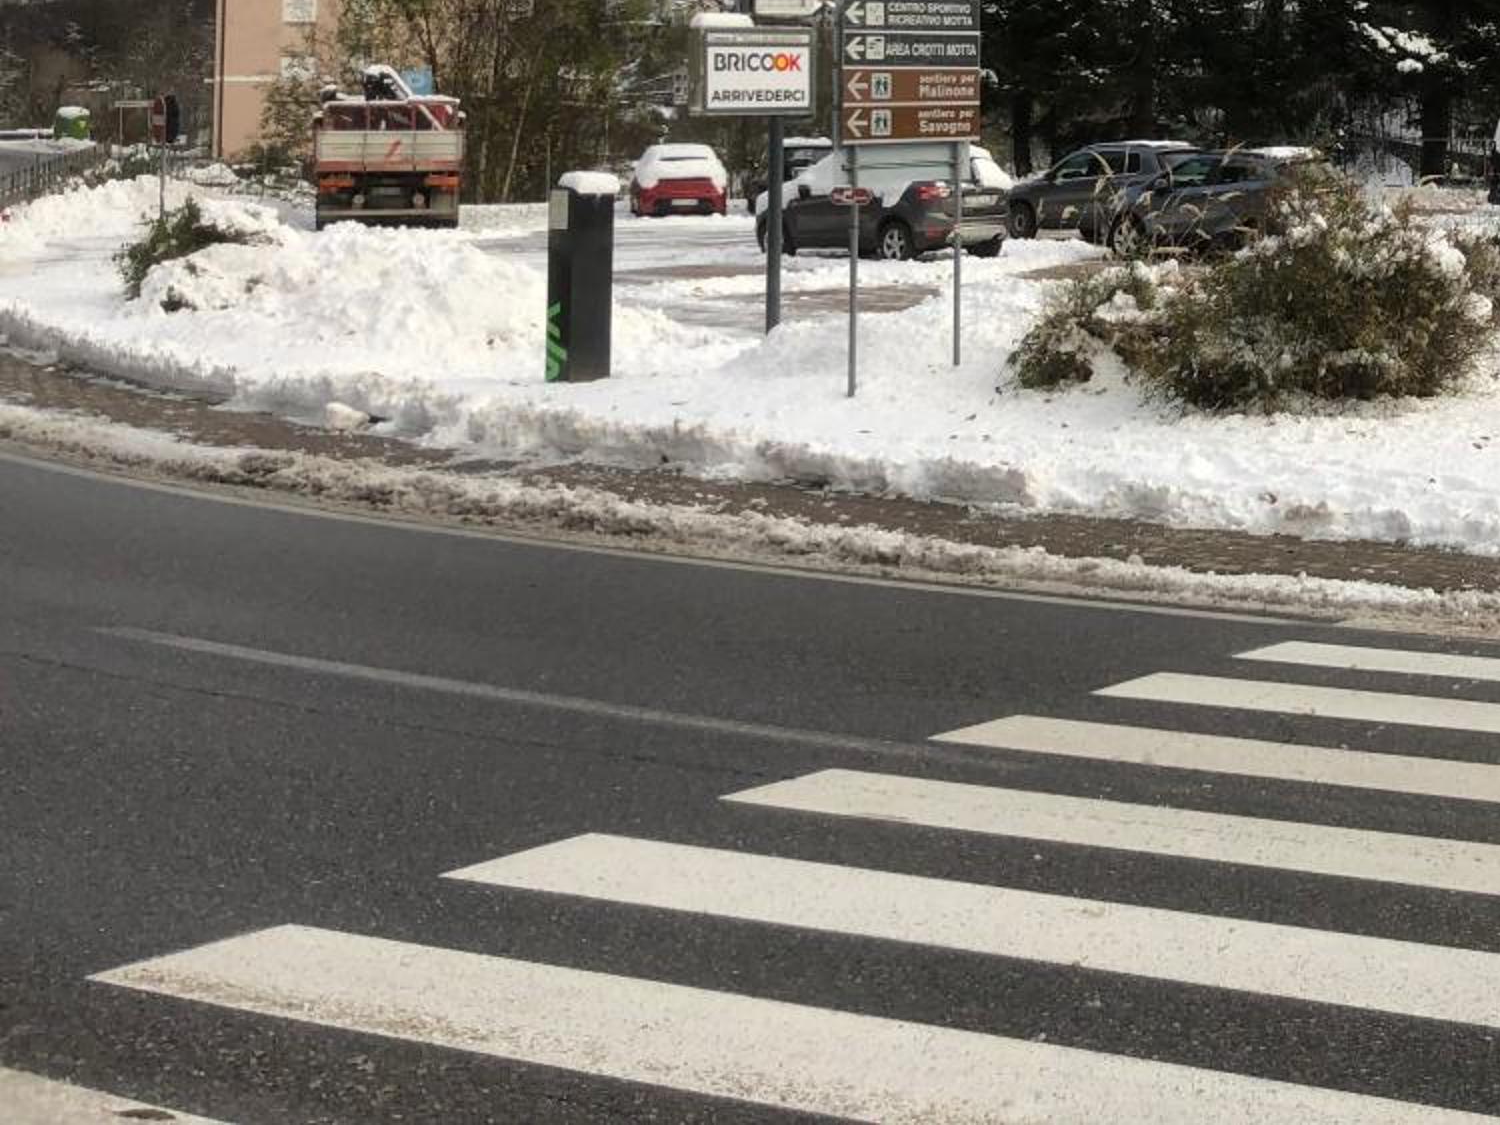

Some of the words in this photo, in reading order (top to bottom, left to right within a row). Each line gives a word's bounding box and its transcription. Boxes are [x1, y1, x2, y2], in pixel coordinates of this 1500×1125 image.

[887, 2, 926, 13] CENTRO
[927, 2, 971, 15] SPORTIVO
[887, 14, 941, 26] RICREATIVO
[943, 16, 973, 26] MOTTA
[885, 42, 910, 56] AREA
[911, 43, 944, 56] CROTTI
[945, 43, 977, 56] MOTTA
[711, 90, 805, 102] ARRIVEDERCI
[919, 120, 972, 135] Savogno
